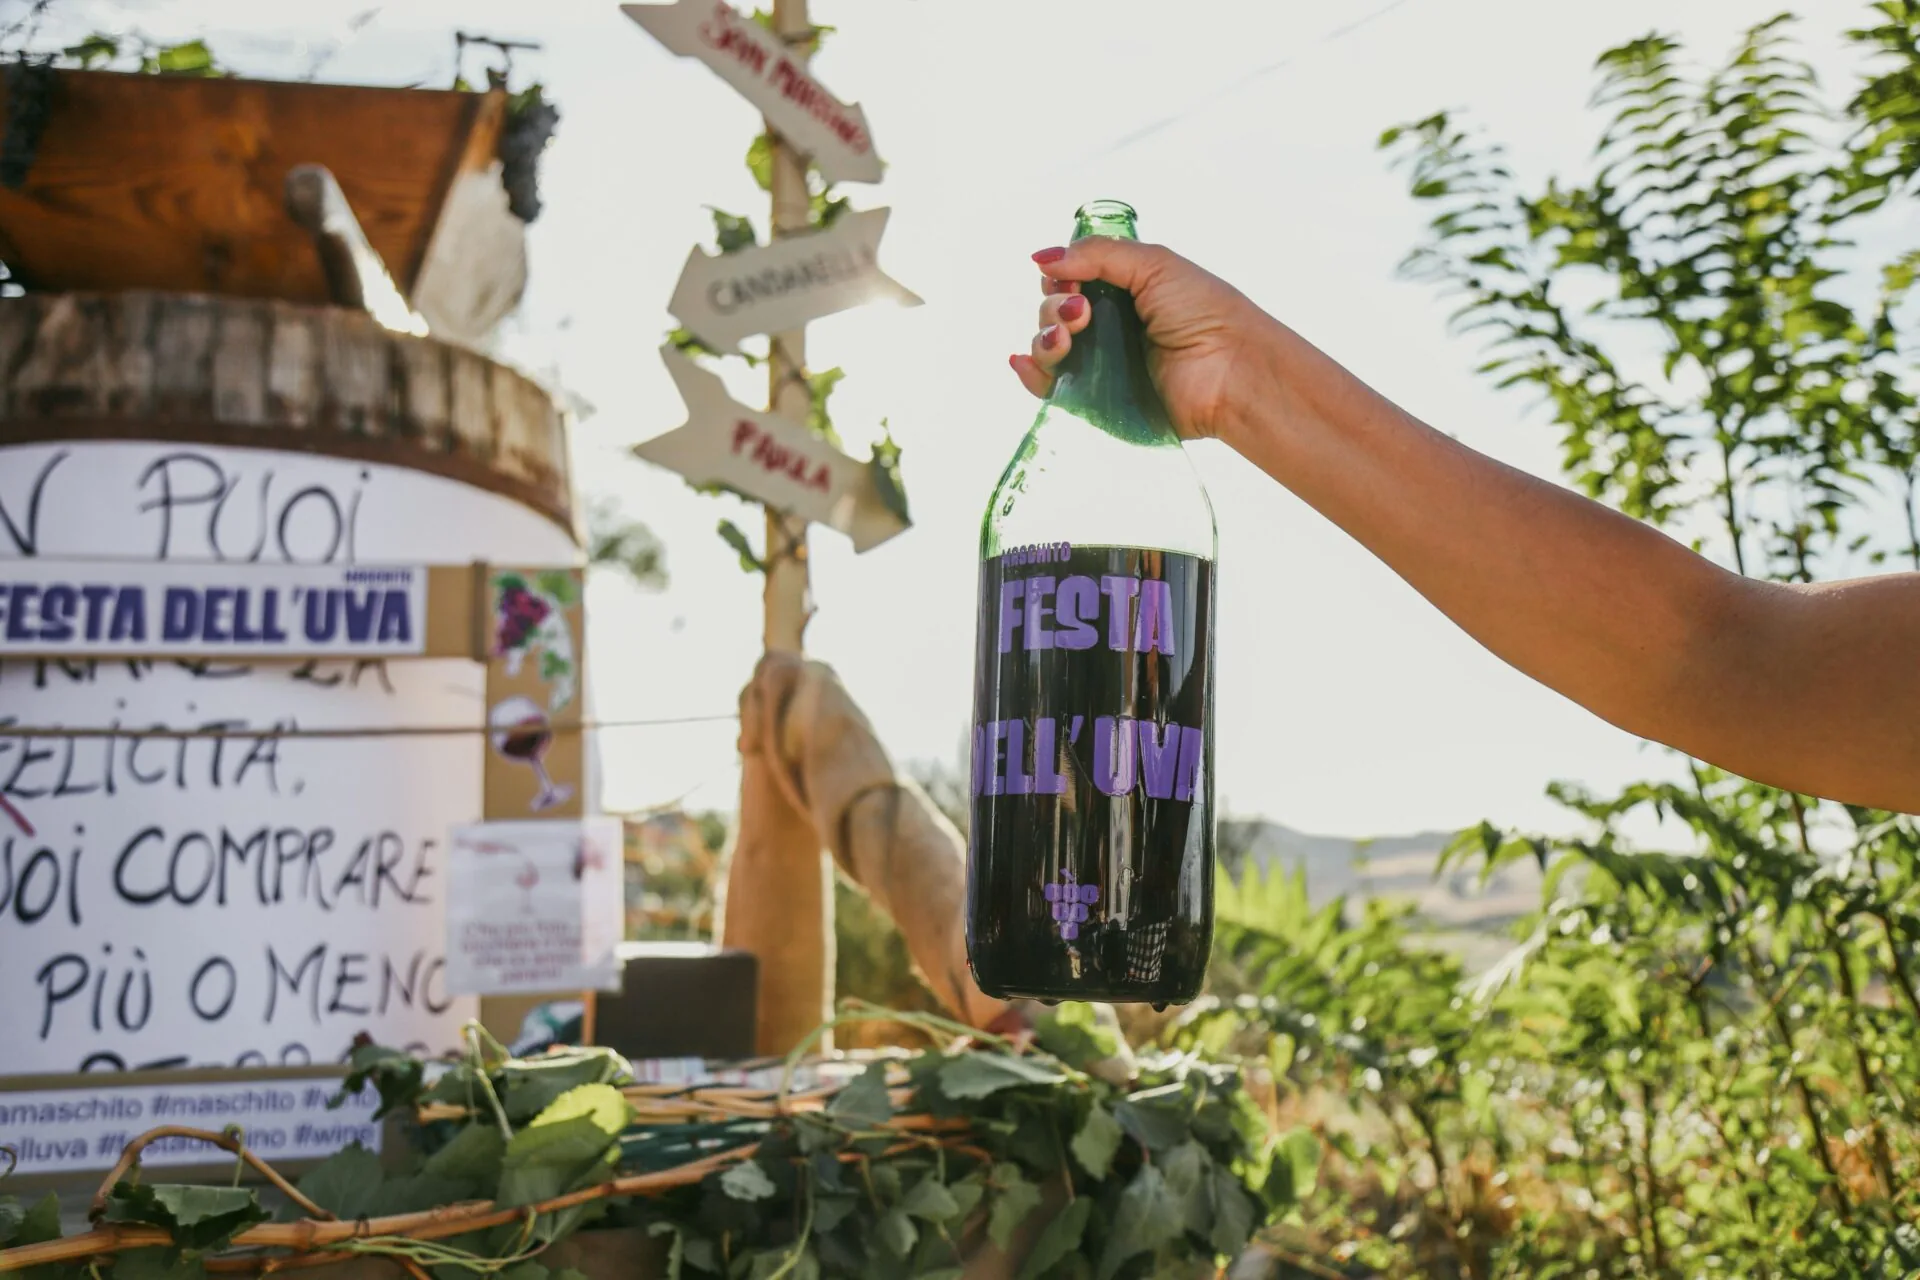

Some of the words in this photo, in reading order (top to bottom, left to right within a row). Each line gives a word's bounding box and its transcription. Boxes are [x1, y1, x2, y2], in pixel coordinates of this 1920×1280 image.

[162, 586, 411, 643] DELL'UVA
[998, 575, 1175, 656] FESTA
[113, 826, 438, 911] COMPRARE
[190, 956, 237, 1021] O
